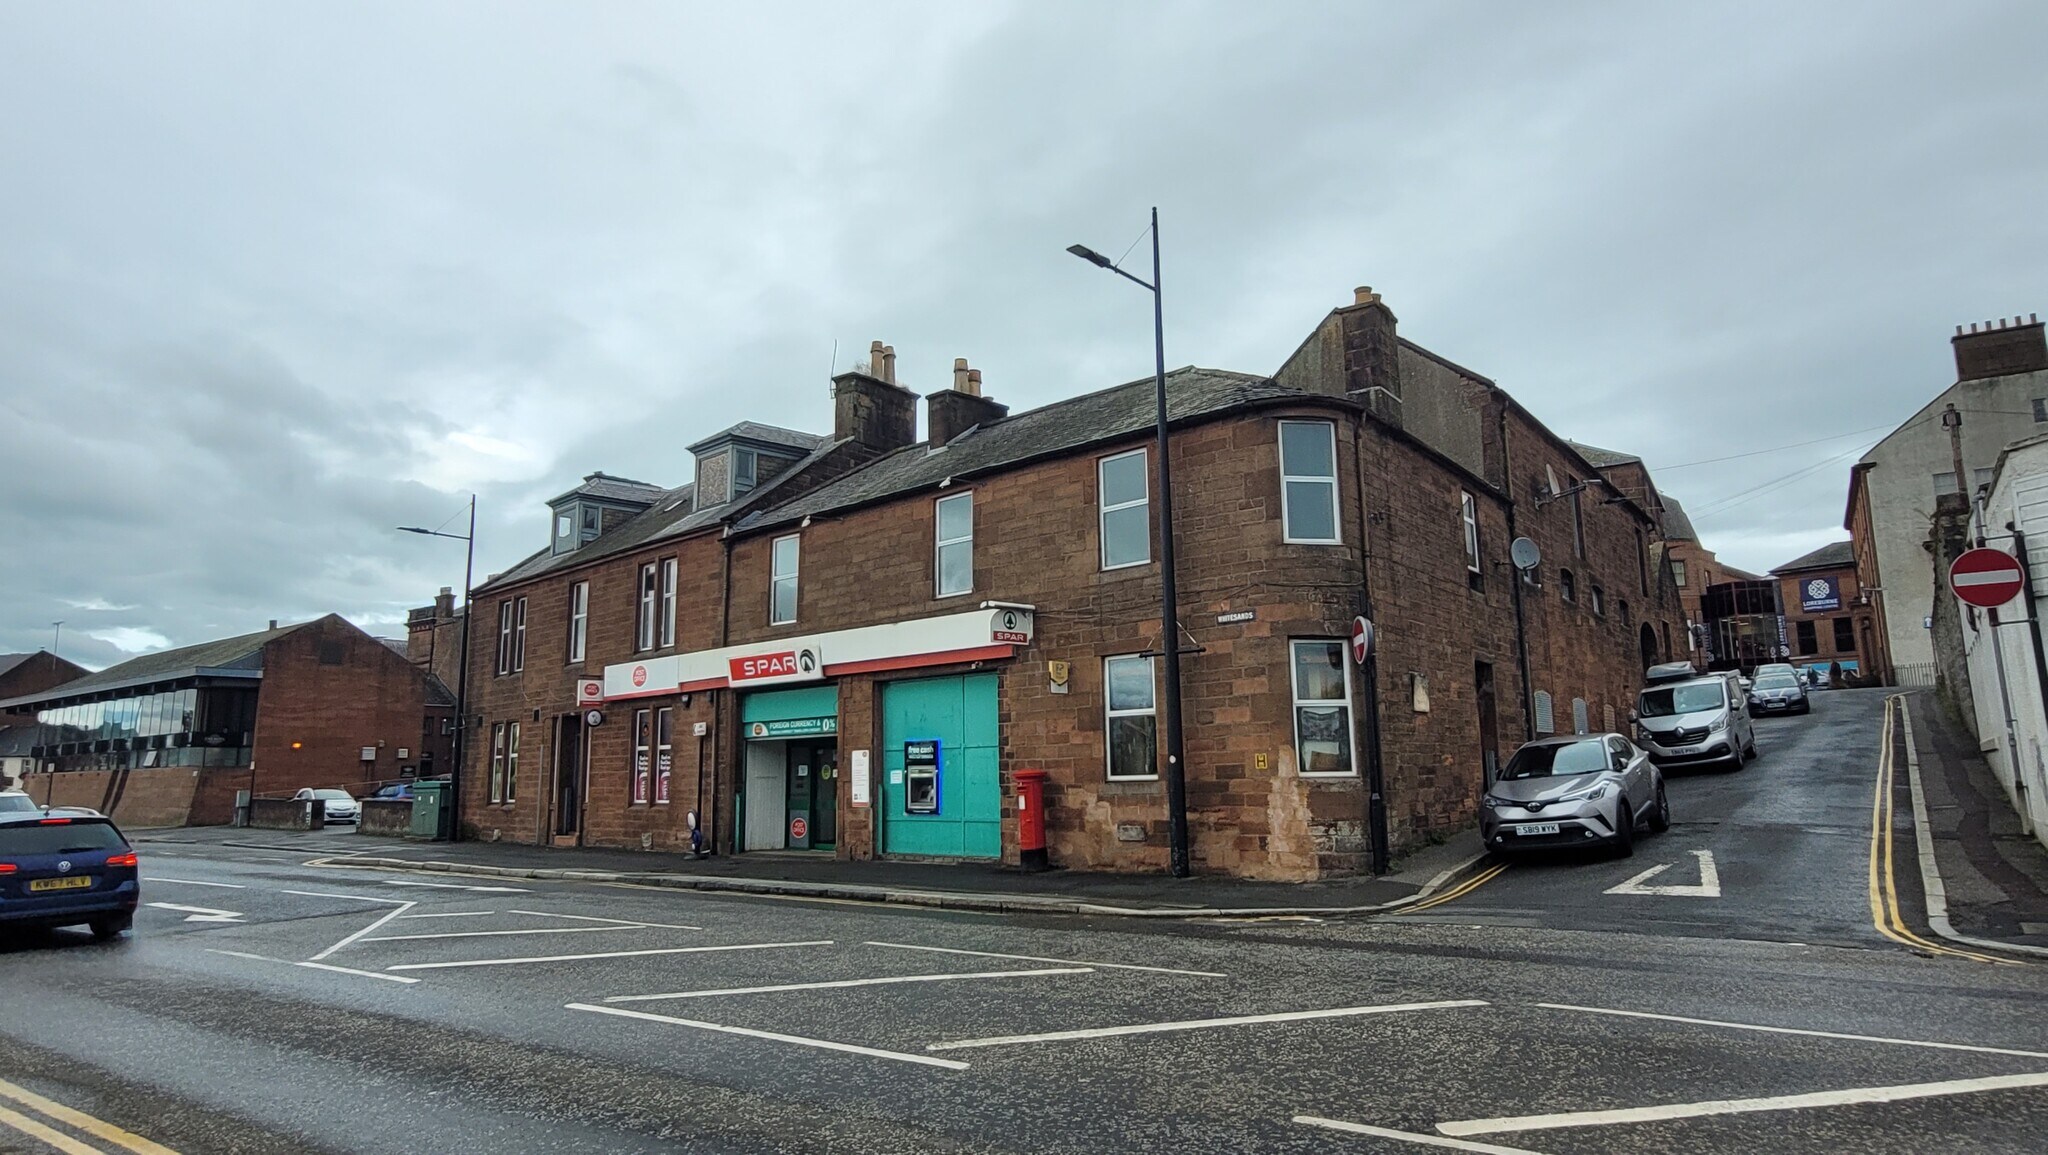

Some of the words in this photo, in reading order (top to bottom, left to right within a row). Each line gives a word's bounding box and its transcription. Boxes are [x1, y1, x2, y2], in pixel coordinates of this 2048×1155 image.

[1803, 598, 1838, 607] LOREBURNE
[1217, 612, 1254, 623] WHITESANDS
[997, 632, 1024, 641] SPAR
[743, 656, 796, 676] SPAR
[769, 722, 790, 730] FOREIGN
[790, 720, 816, 728] CURRENCY
[908, 745, 920, 754] free
[920, 745, 934, 754] cash
[1257, 755, 1266, 767] H
[1522, 826, 1540, 834] SB19
[1541, 824, 1557, 832] WYK
